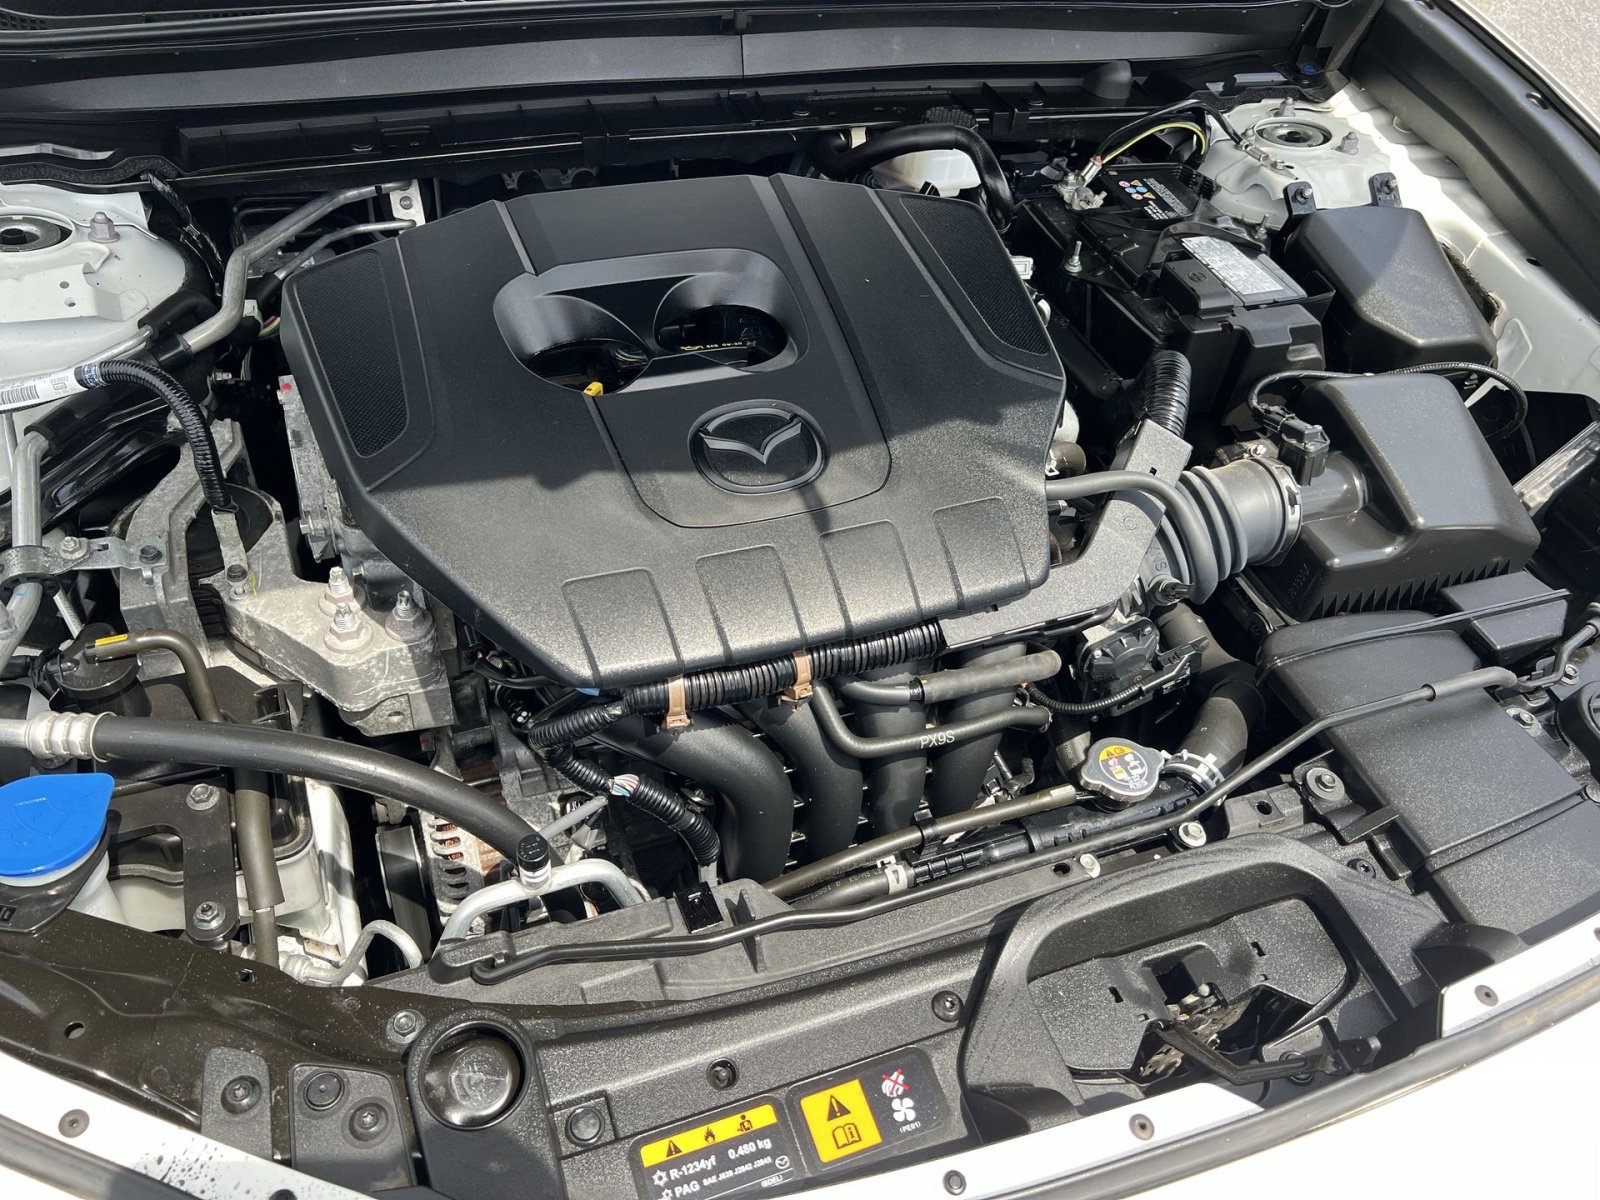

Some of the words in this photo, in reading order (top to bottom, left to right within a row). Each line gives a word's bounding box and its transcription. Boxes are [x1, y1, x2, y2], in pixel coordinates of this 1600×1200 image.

[920, 730, 955, 749] PX9S
[669, 1155, 716, 1180] R-1234yf
[728, 1141, 756, 1159] 0.480
[757, 1138, 772, 1150] kg
[674, 1181, 700, 1198] PAG
[702, 1176, 717, 1186] SAE
